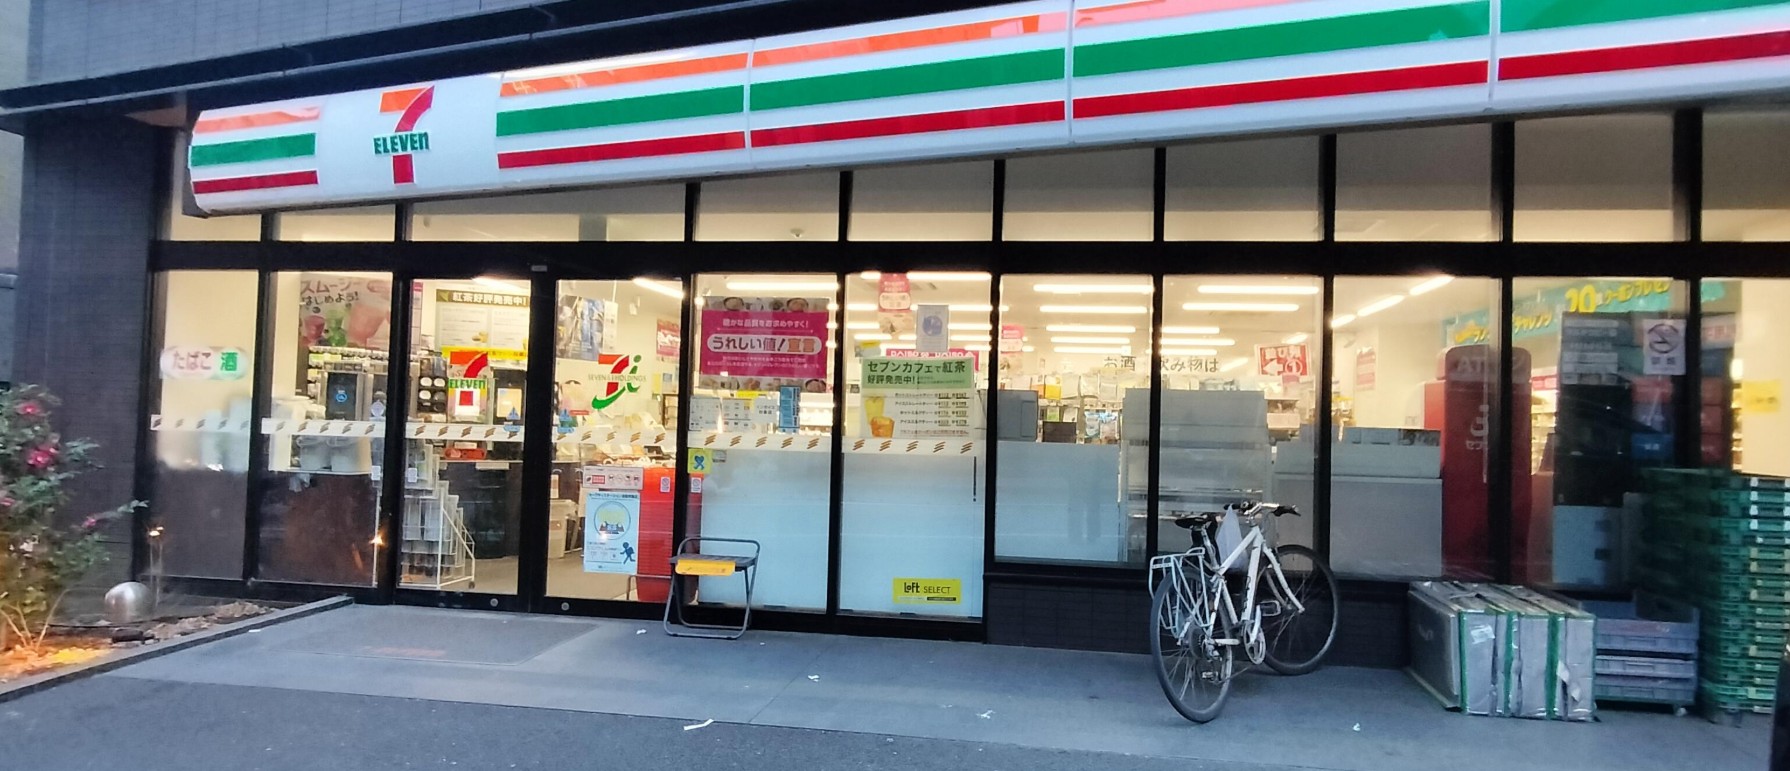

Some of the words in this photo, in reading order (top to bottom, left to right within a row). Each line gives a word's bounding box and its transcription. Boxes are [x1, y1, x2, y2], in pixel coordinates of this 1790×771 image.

[300, 278, 361, 294] スムージー
[452, 292, 526, 306] 紅茶好評発売中!
[712, 336, 815, 353] うれしい値!宣言
[173, 351, 212, 370] たばこ
[220, 352, 238, 371] 酒
[867, 360, 966, 373] セブンカフェで紅茶
[867, 374, 915, 385] 好評発売中!
[923, 586, 951, 594] SELECT
